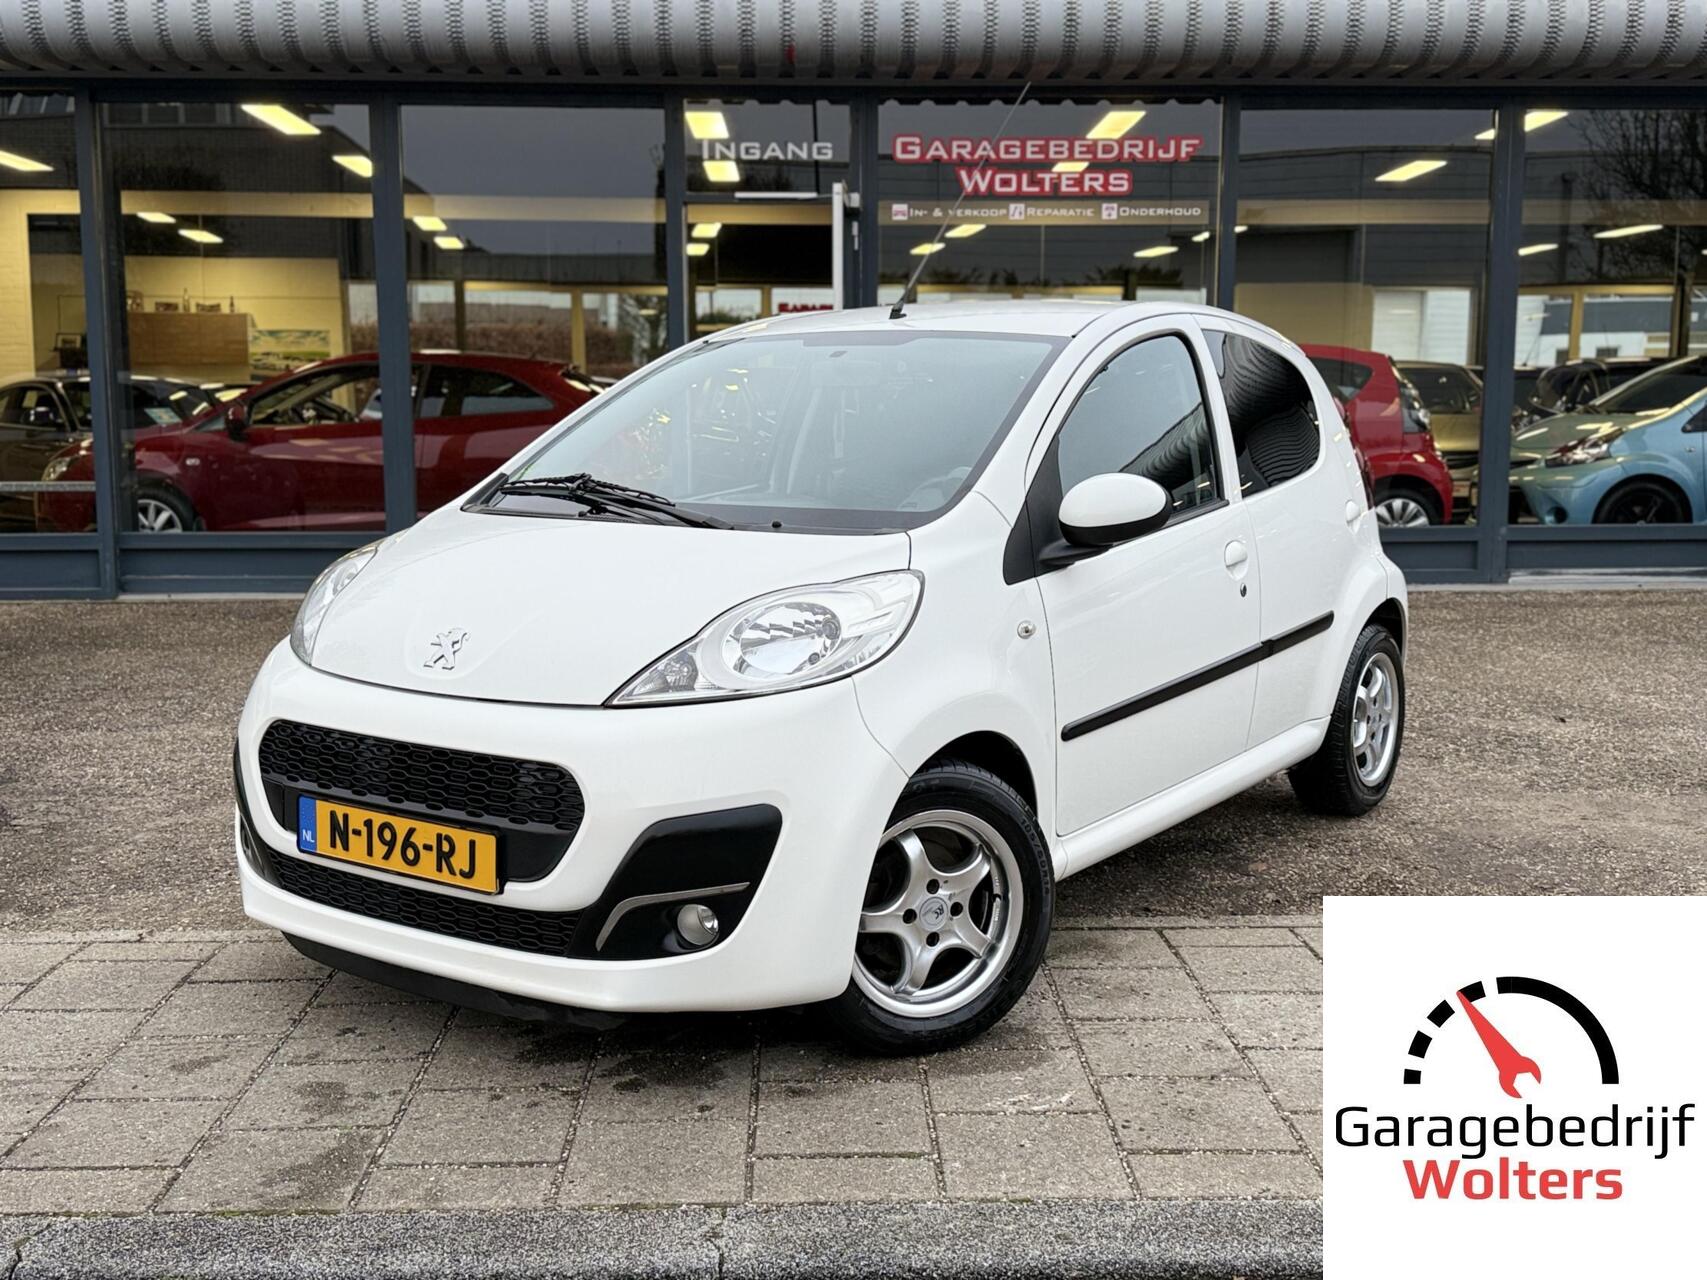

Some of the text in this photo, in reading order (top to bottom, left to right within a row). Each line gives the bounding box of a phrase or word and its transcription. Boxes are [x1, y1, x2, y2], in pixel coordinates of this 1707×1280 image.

[702, 139, 833, 160] INGANG
[894, 135, 1201, 161] GARAGEBEDRIJF
[958, 168, 1131, 194] WOLTERS
[932, 207, 943, 218] &
[1026, 207, 1094, 217] REPARATIE
[1119, 207, 1201, 217] ONDERHOUD
[302, 829, 315, 843] NL
[329, 809, 477, 880] N-196-RJ
